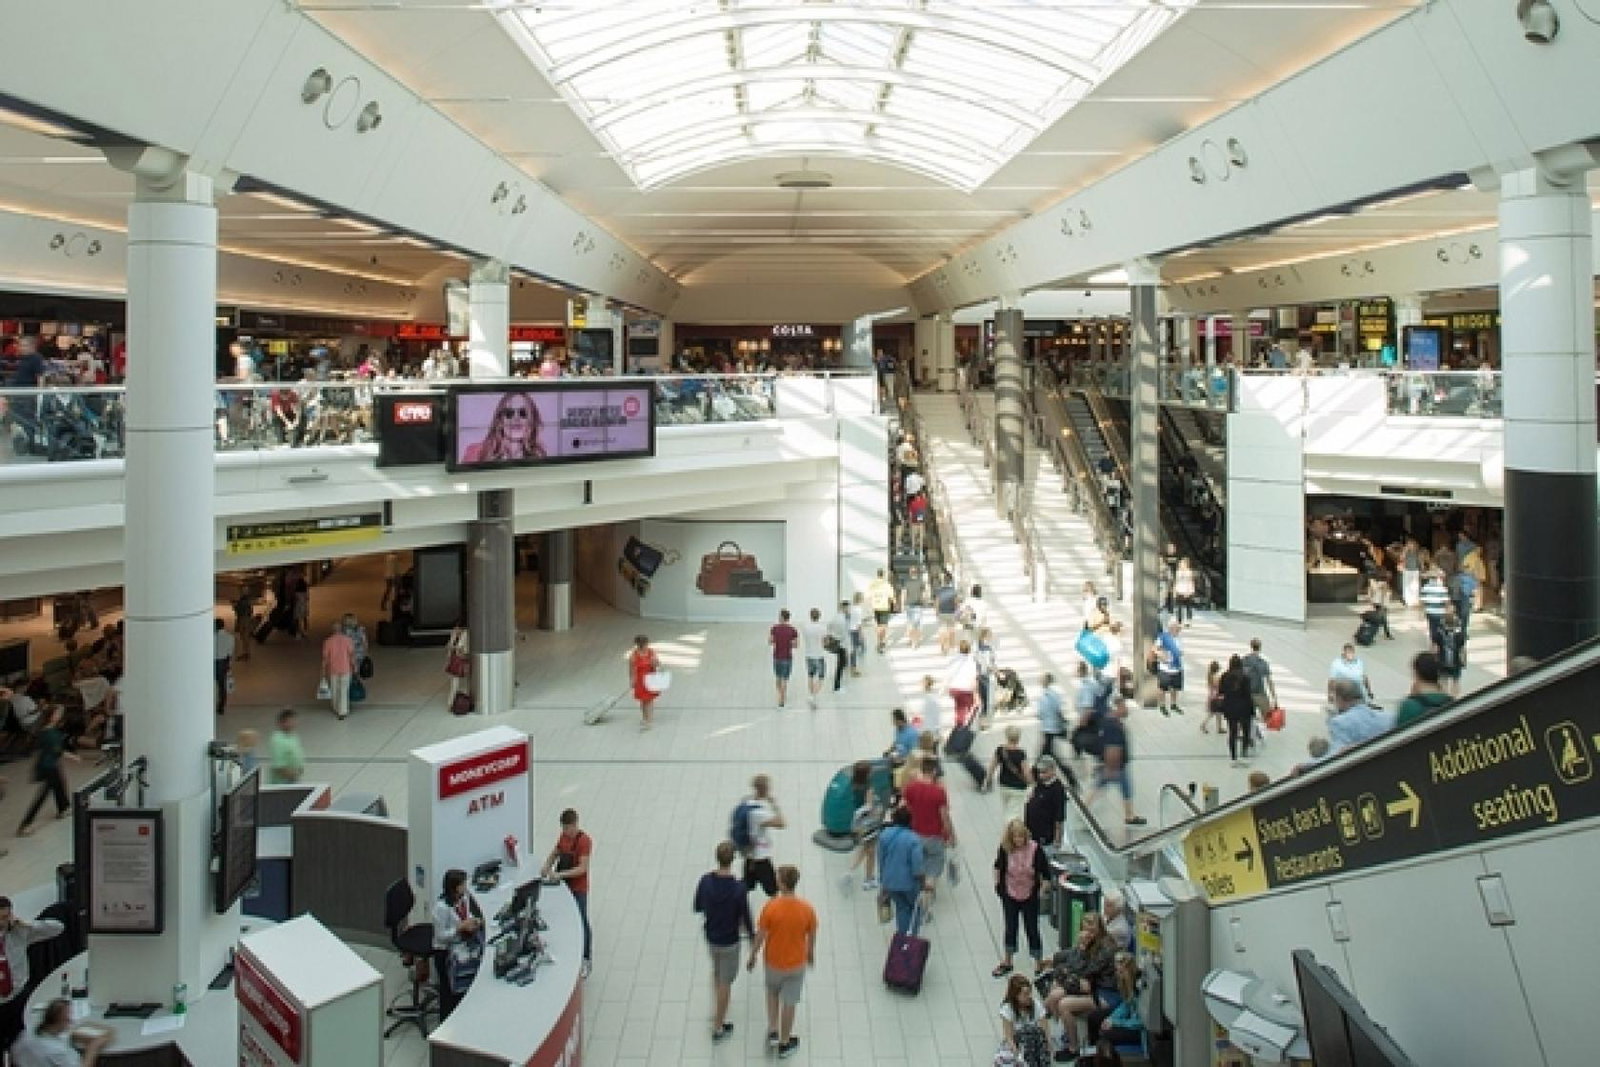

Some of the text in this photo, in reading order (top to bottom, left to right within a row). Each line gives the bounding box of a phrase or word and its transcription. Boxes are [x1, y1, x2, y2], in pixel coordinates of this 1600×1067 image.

[1429, 714, 1536, 784] Additional
[448, 753, 520, 787] MONEYCORP
[466, 788, 505, 817] ATM
[1472, 783, 1558, 830] seating
